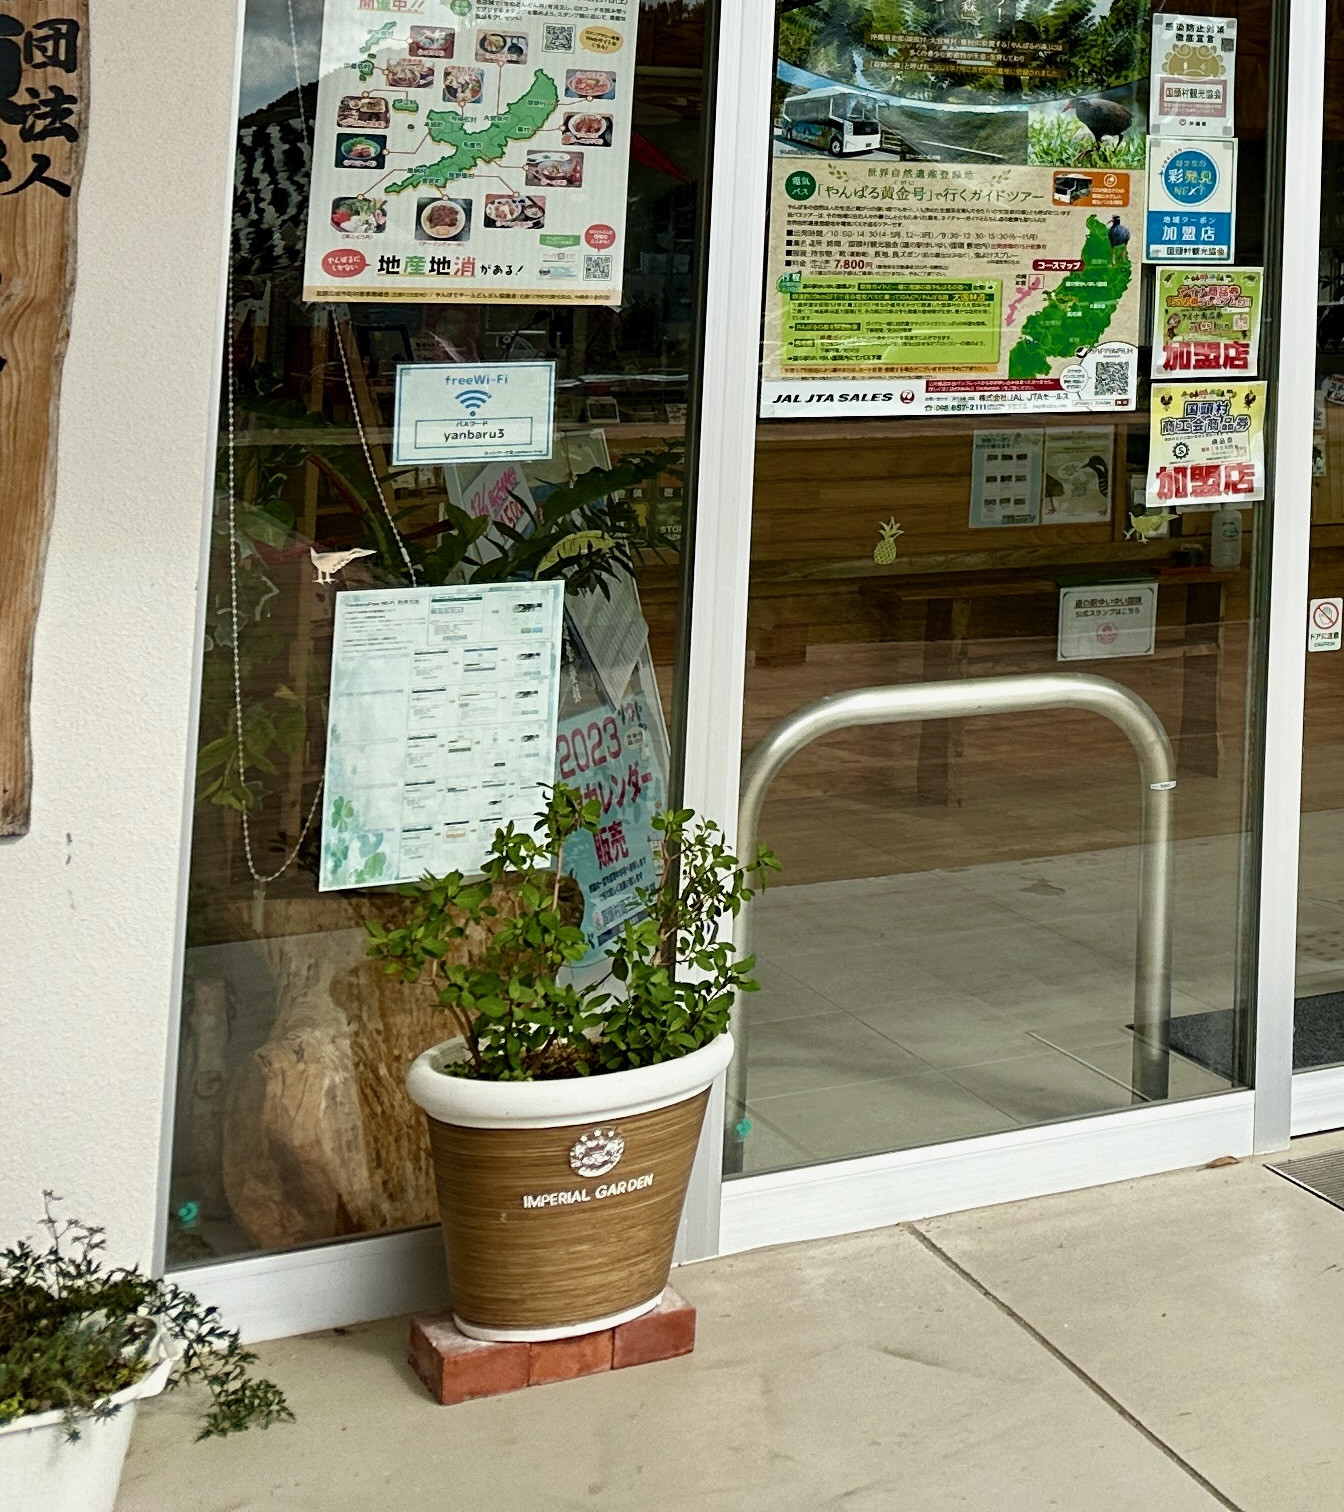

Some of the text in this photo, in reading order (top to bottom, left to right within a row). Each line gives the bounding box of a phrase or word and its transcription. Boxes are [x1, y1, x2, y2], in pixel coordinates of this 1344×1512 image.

[868, 167, 974, 181] 世界自然遺産登録地
[1167, 168, 1213, 185] 彩発見
[1173, 185, 1206, 196] NEXT
[1161, 225, 1216, 241] 加盟店
[1037, 261, 1081, 270] コースマップ
[1162, 340, 1251, 371] 加盟店
[445, 374, 508, 385] freeWi-Fi
[772, 392, 894, 404] JAL JTA SALES
[1185, 400, 1231, 417] 国頭村
[1160, 414, 1251, 436] 商工会商品券
[443, 428, 505, 442] yanbaru3
[1155, 462, 1256, 500] 加盟店
[556, 715, 623, 781] 2023
[592, 821, 630, 870] 販売
[522, 1172, 655, 1209] IMPERIAL GARDEN
